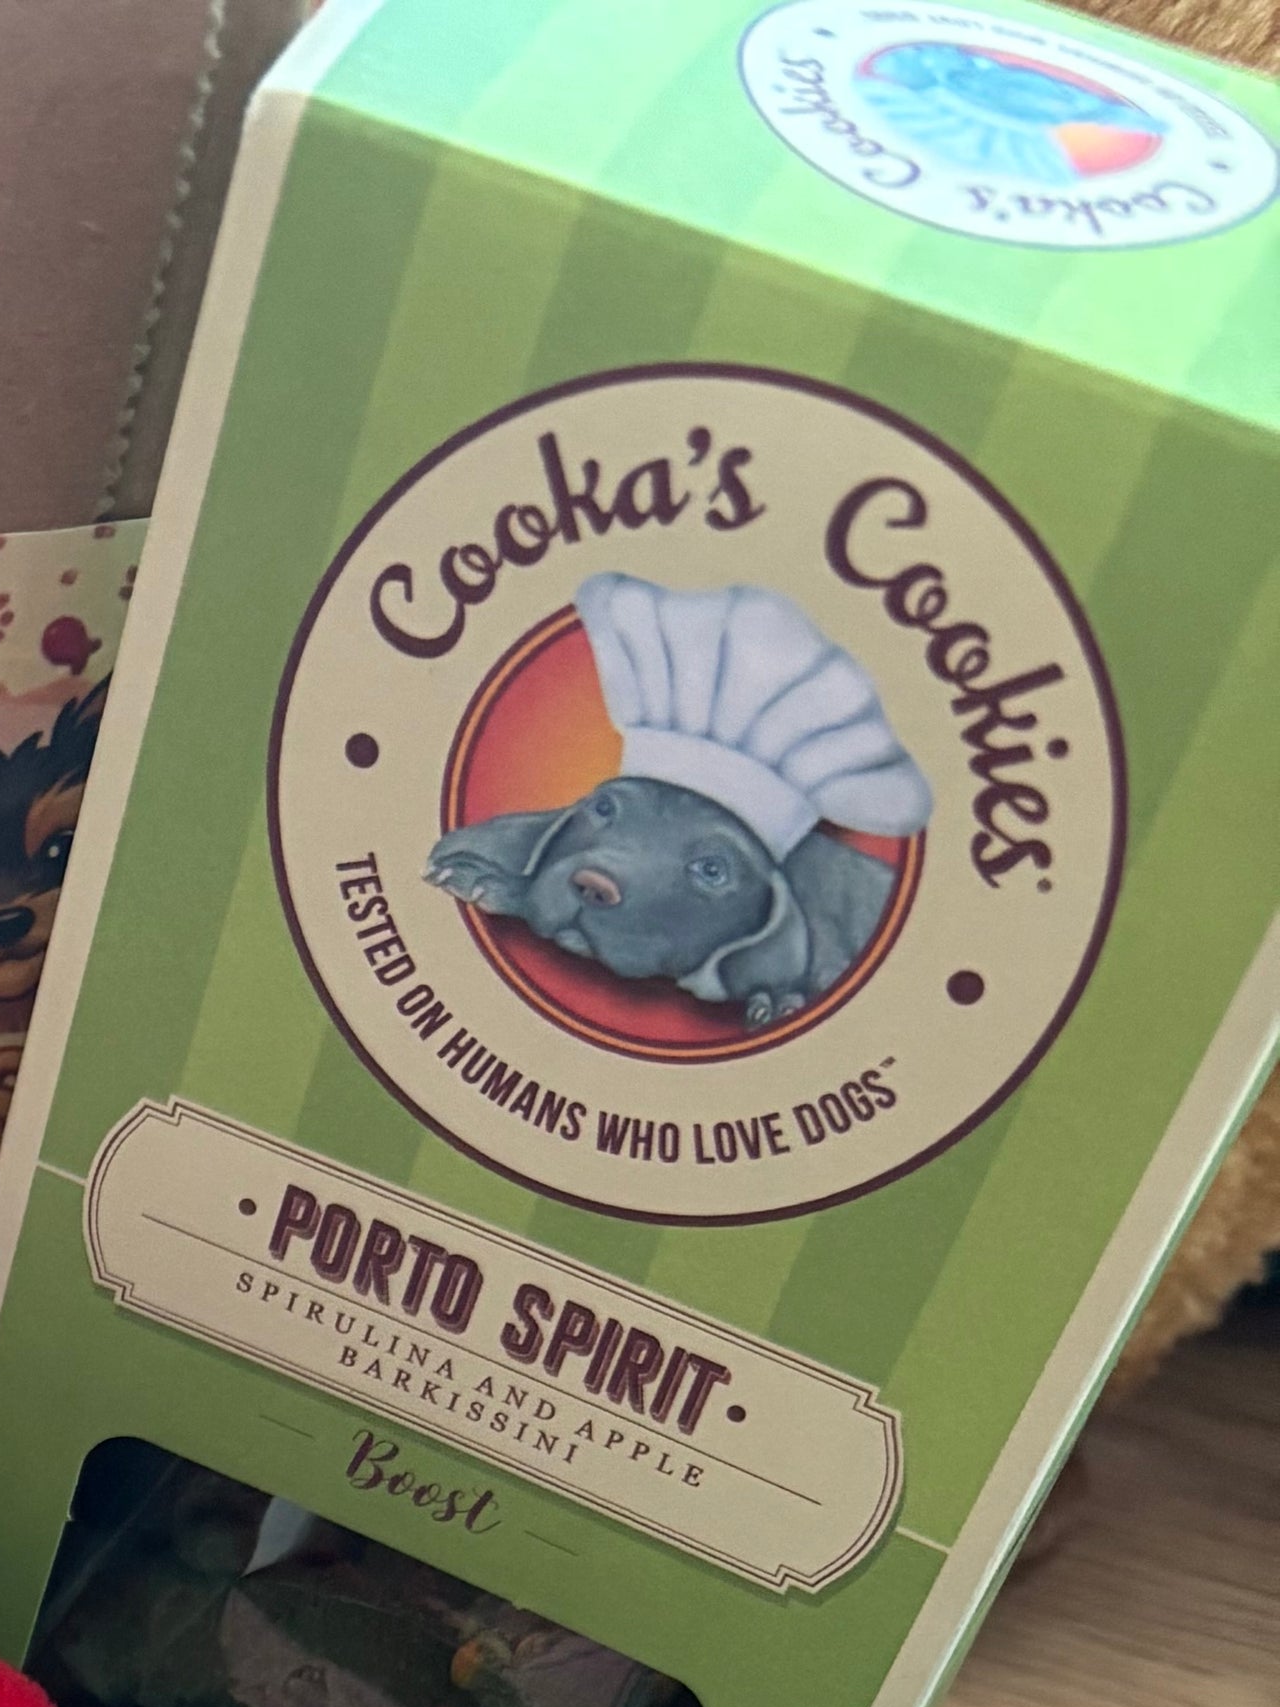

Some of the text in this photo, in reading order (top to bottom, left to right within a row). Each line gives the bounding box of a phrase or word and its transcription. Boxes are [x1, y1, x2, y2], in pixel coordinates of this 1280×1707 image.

[371, 426, 1070, 892] Cooka's Cookies
[335, 852, 415, 990] TESTED
[396, 982, 450, 1040] ON
[438, 1029, 588, 1143] HUMANS
[597, 1110, 681, 1165] WHO
[694, 1114, 792, 1166] LOVE
[235, 1272, 706, 1489] SPIRULINA AND APPLE
[268, 1184, 733, 1437] PORTO SPIRIT
[338, 1344, 581, 1465] BARKISSINI
[344, 1428, 505, 1536] Boost
